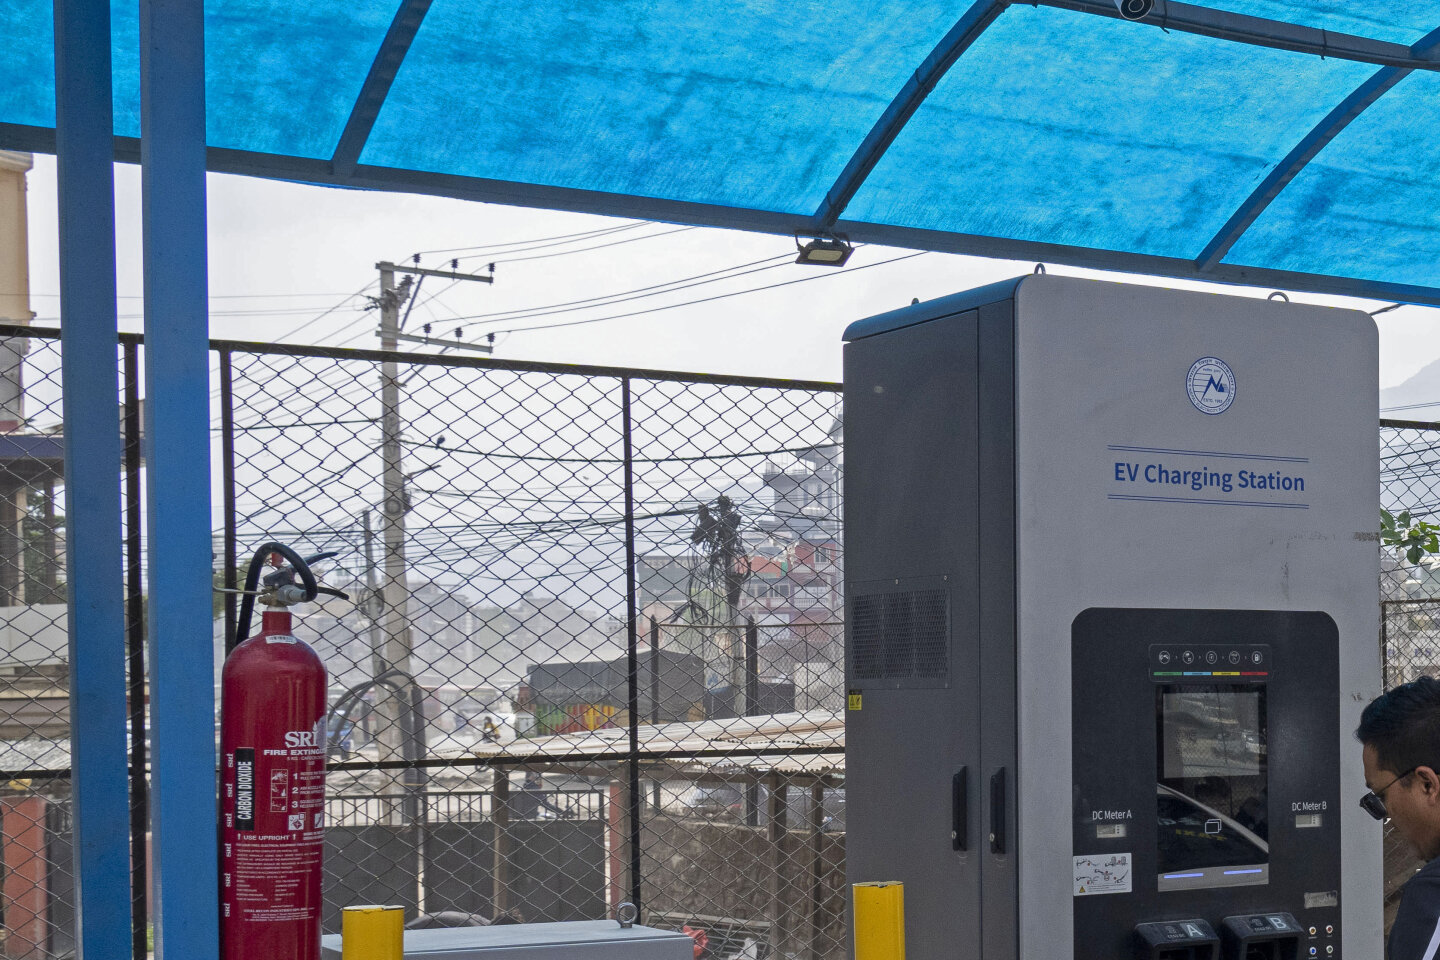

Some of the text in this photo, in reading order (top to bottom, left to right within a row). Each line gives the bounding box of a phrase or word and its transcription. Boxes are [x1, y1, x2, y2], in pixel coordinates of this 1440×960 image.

[1114, 462, 1305, 493] EV Charging Station
[285, 722, 319, 748] SRI
[237, 761, 252, 820] CARBON DIOXIDE
[1292, 801, 1327, 811] DC Meter B
[1092, 810, 1132, 820] DC Meter A
[1269, 917, 1287, 930] B
[1186, 924, 1203, 937] A
